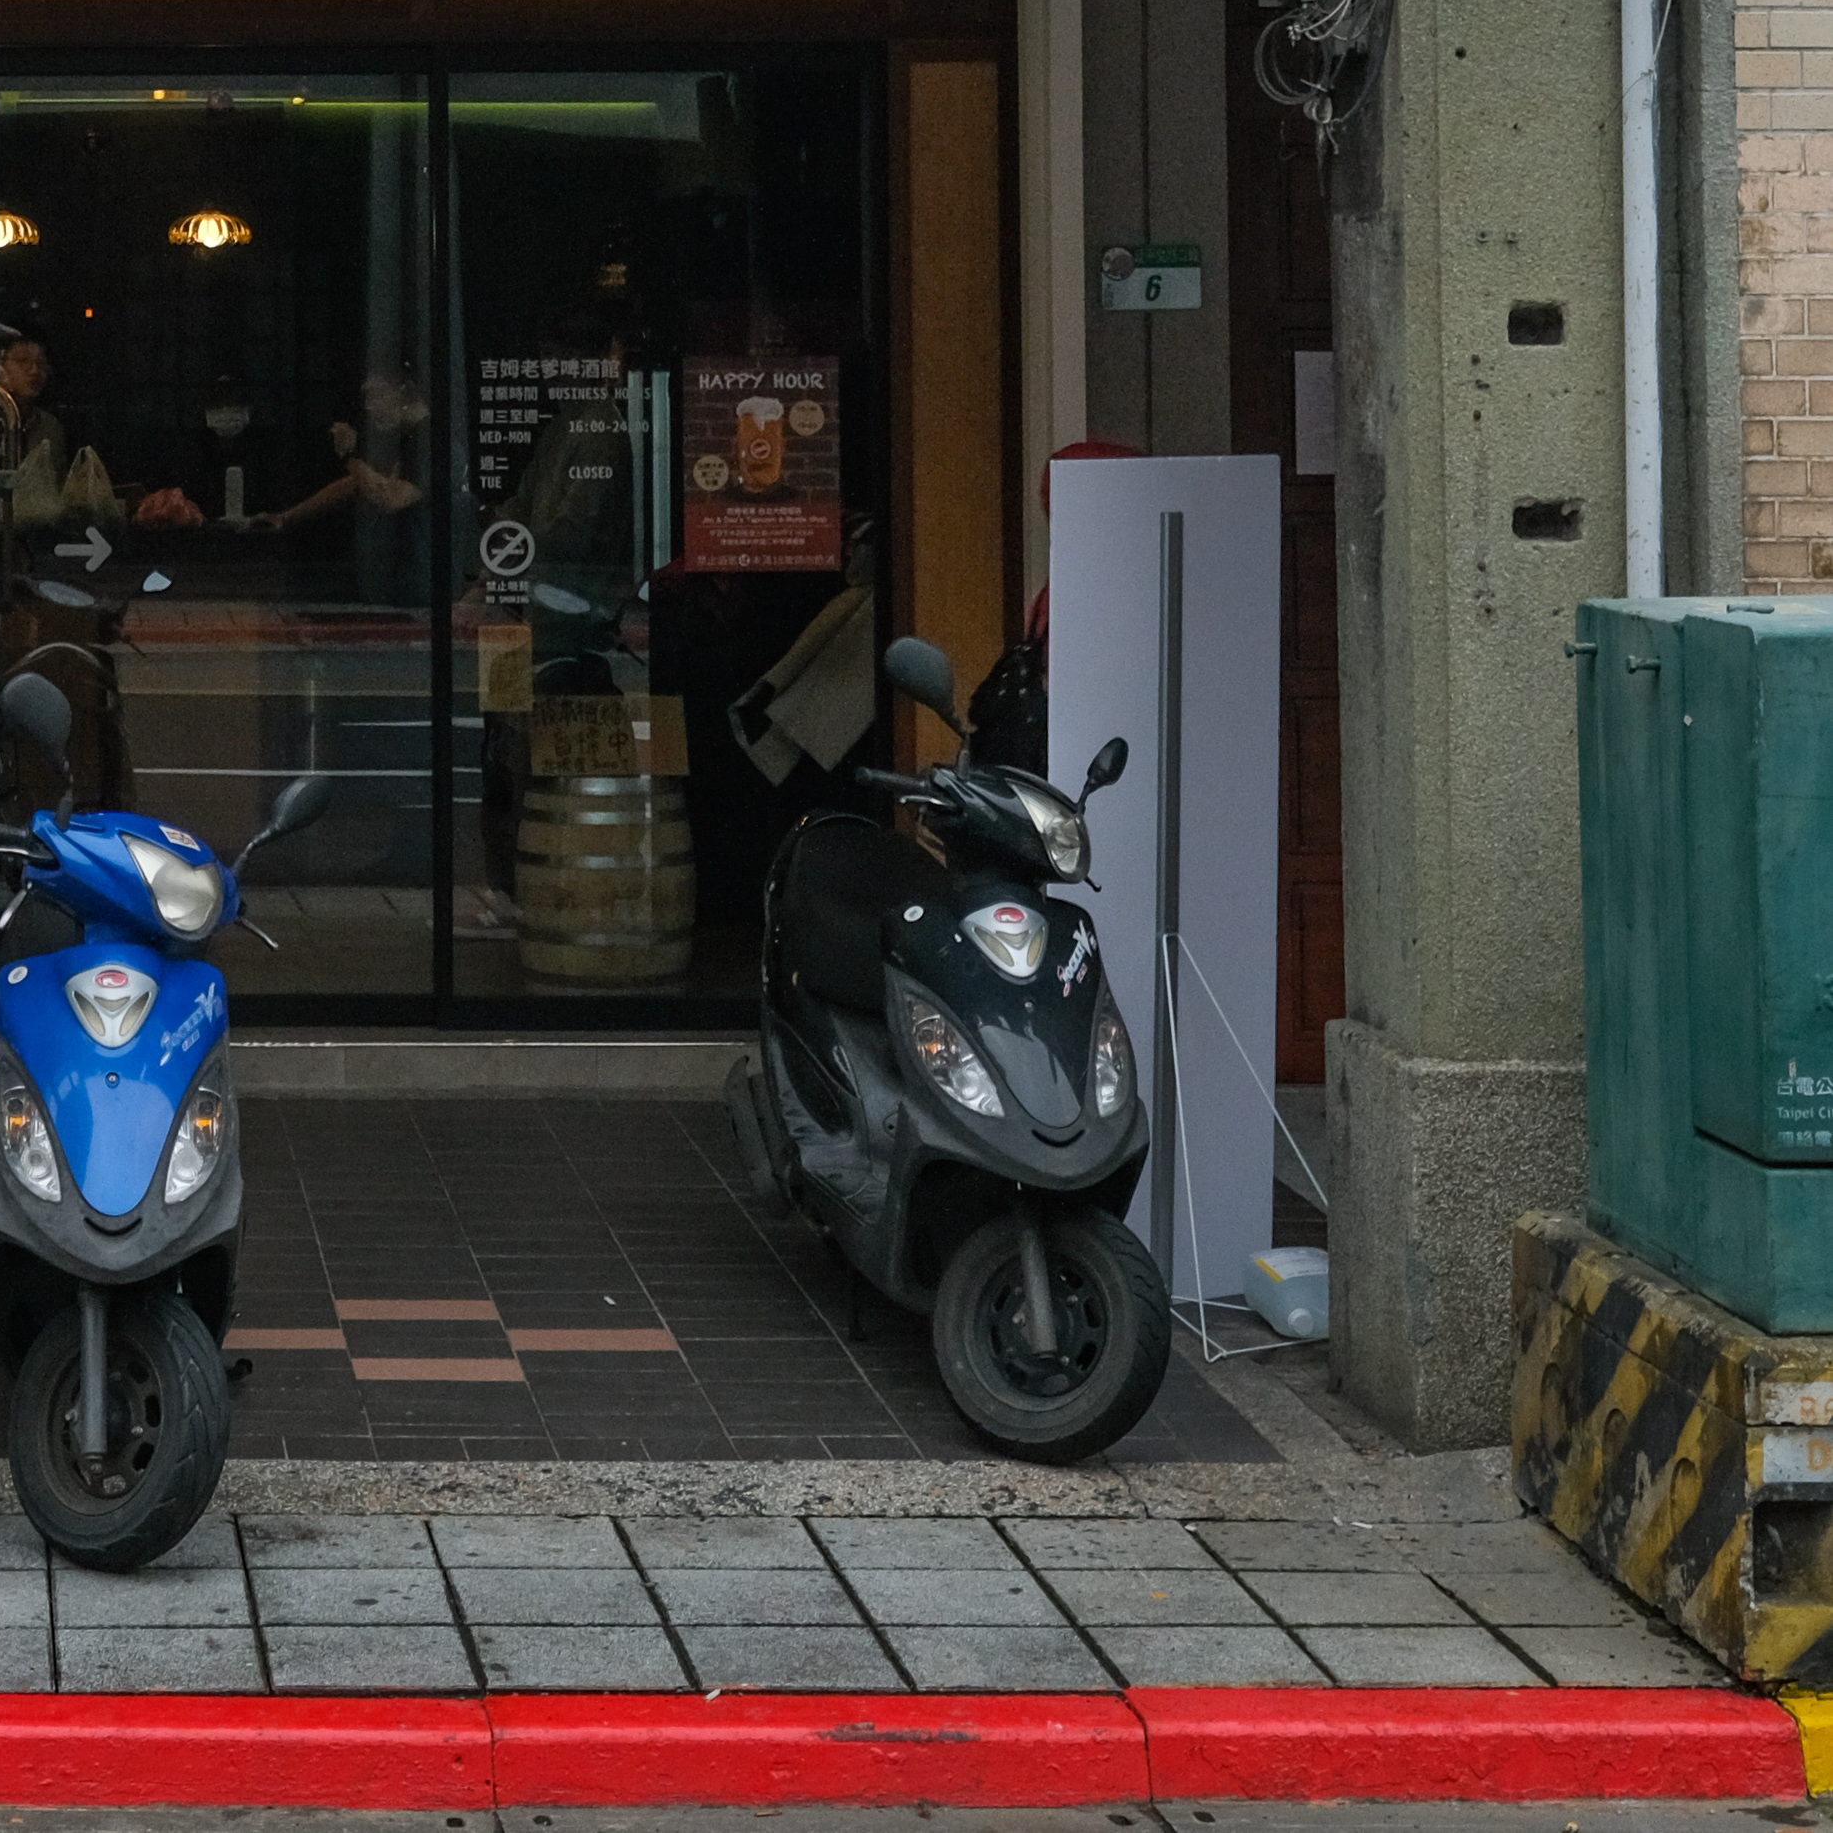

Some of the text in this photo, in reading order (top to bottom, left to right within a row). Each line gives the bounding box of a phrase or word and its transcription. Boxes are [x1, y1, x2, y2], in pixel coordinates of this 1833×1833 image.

[1144, 274, 1163, 303] 6
[480, 358, 621, 379] 吉姆老爹啤酒館
[698, 371, 826, 390] HAPPY HOUR
[480, 386, 652, 401] 營業時間 BUSINESS HOS
[479, 409, 553, 424] 週三至週一
[568, 420, 650, 433] 16:00-2400
[479, 430, 532, 444] WED-MON
[480, 455, 509, 470] 週二
[568, 466, 613, 479] CLOSED
[479, 475, 502, 489] TUE
[1776, 1105, 1833, 1121] Taipei Ci
